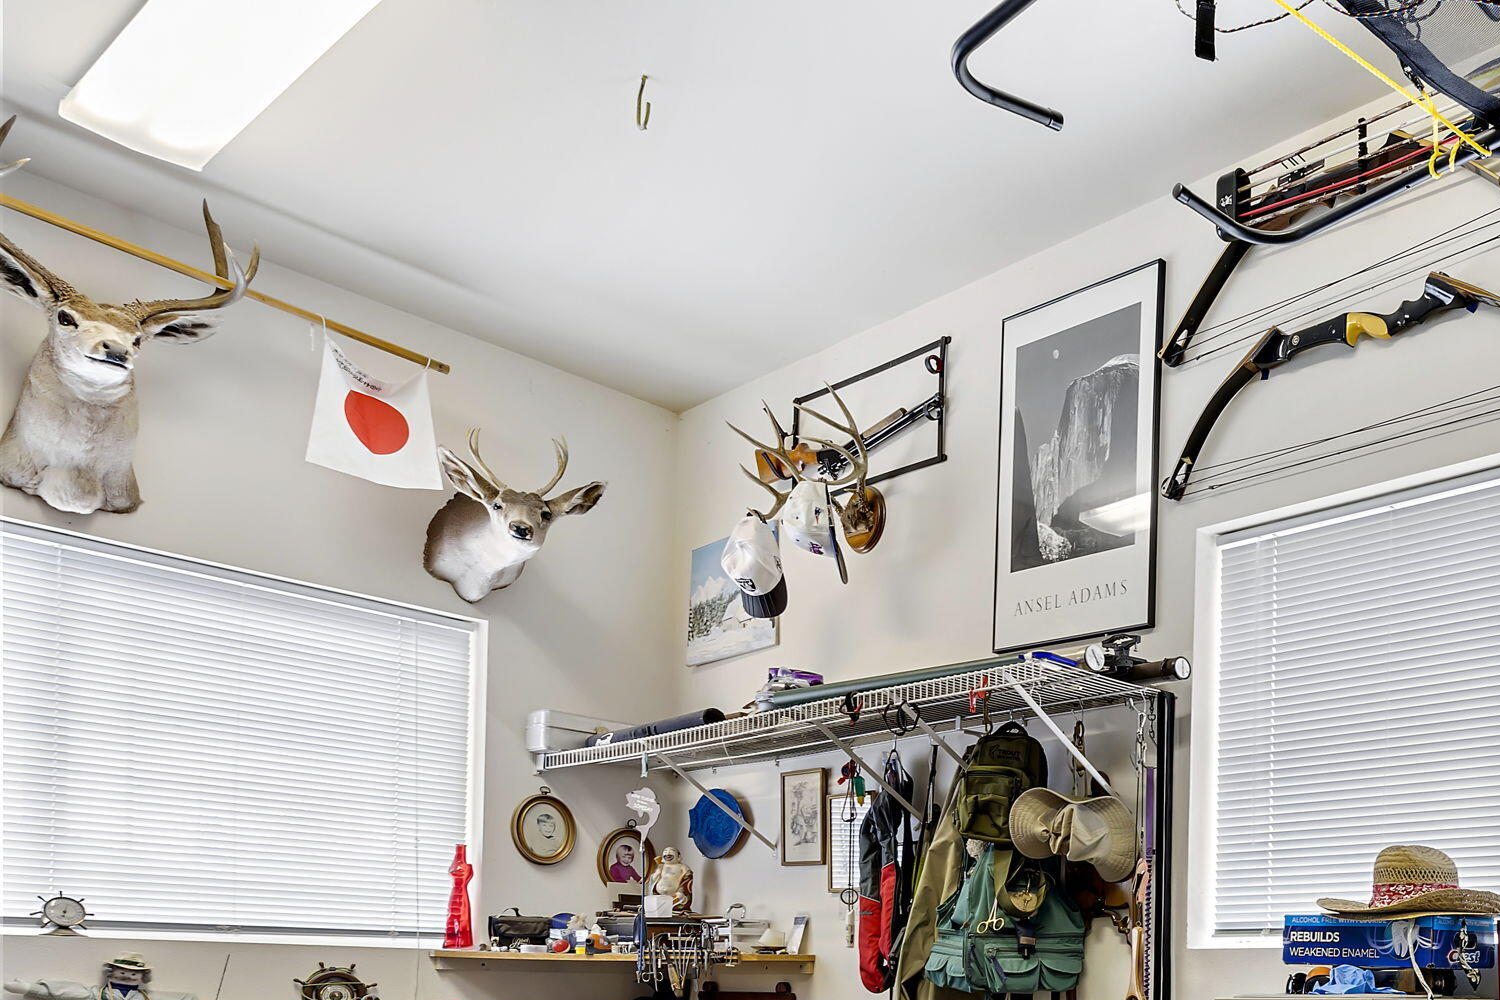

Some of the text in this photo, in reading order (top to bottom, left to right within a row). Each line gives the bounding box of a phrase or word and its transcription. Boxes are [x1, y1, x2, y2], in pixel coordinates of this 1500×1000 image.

[1014, 579, 1128, 616] ANSEL ADAMS
[1290, 931, 1340, 942] REBUILDS
[1289, 947, 1380, 959] WEAKENED ENAMEL
